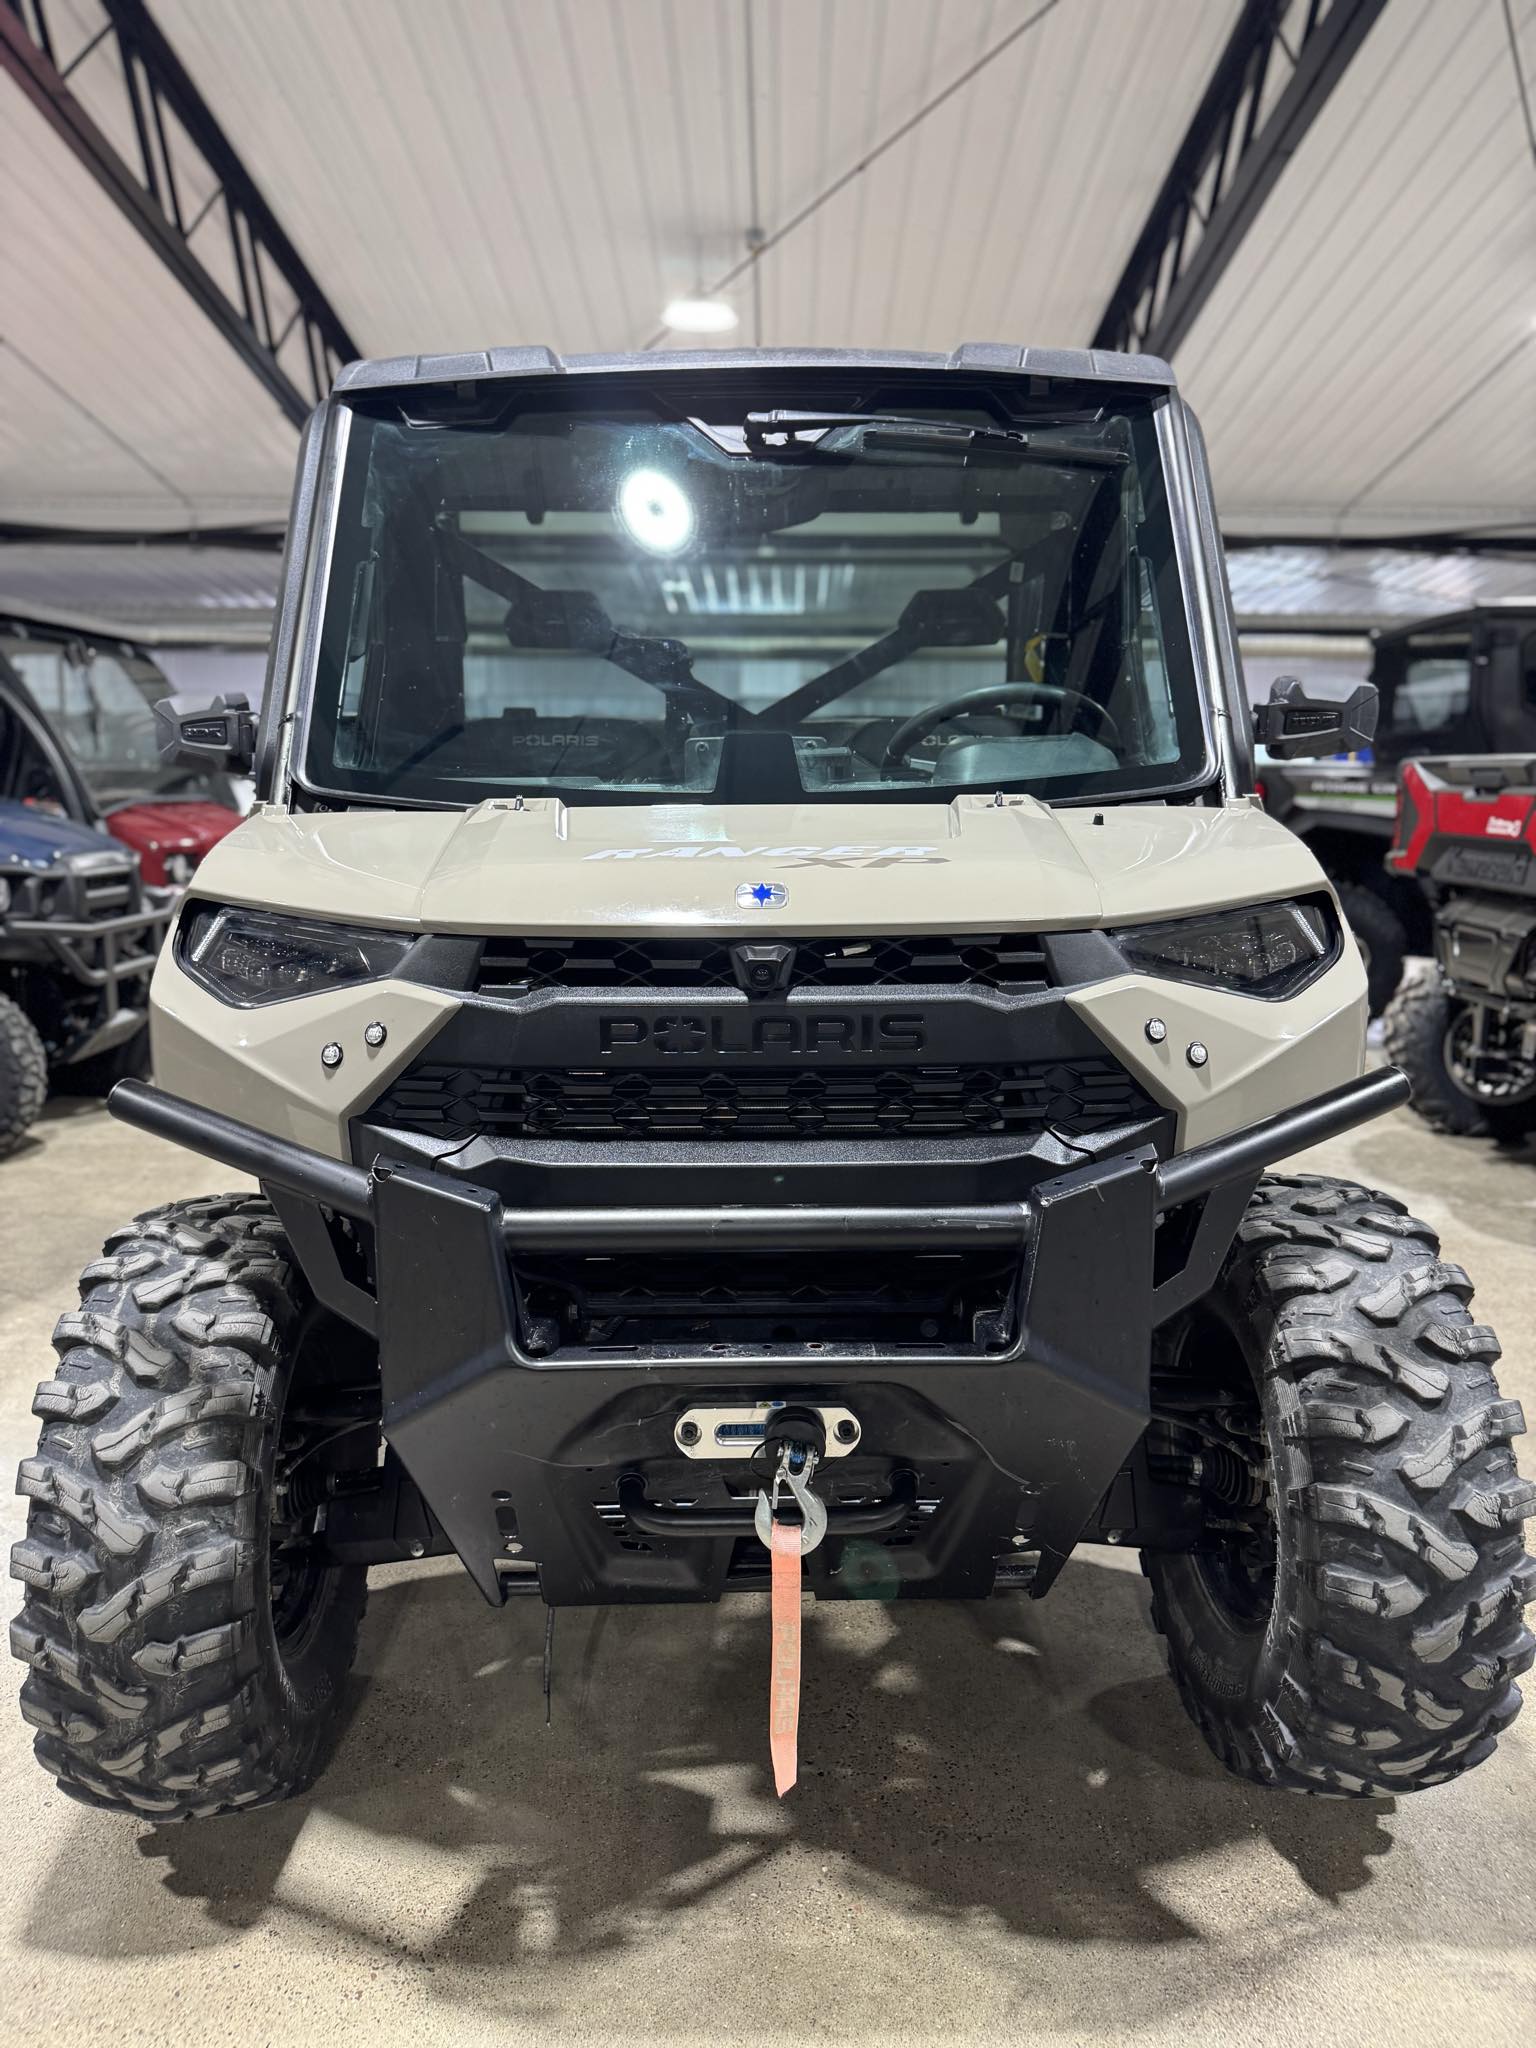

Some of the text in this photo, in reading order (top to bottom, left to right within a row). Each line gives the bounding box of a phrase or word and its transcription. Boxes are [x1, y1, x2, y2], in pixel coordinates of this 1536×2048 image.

[512, 734, 600, 747] POLARIS
[581, 846, 939, 861] RANGER
[772, 857, 953, 869] XP
[600, 1014, 926, 1055] POLARIS
